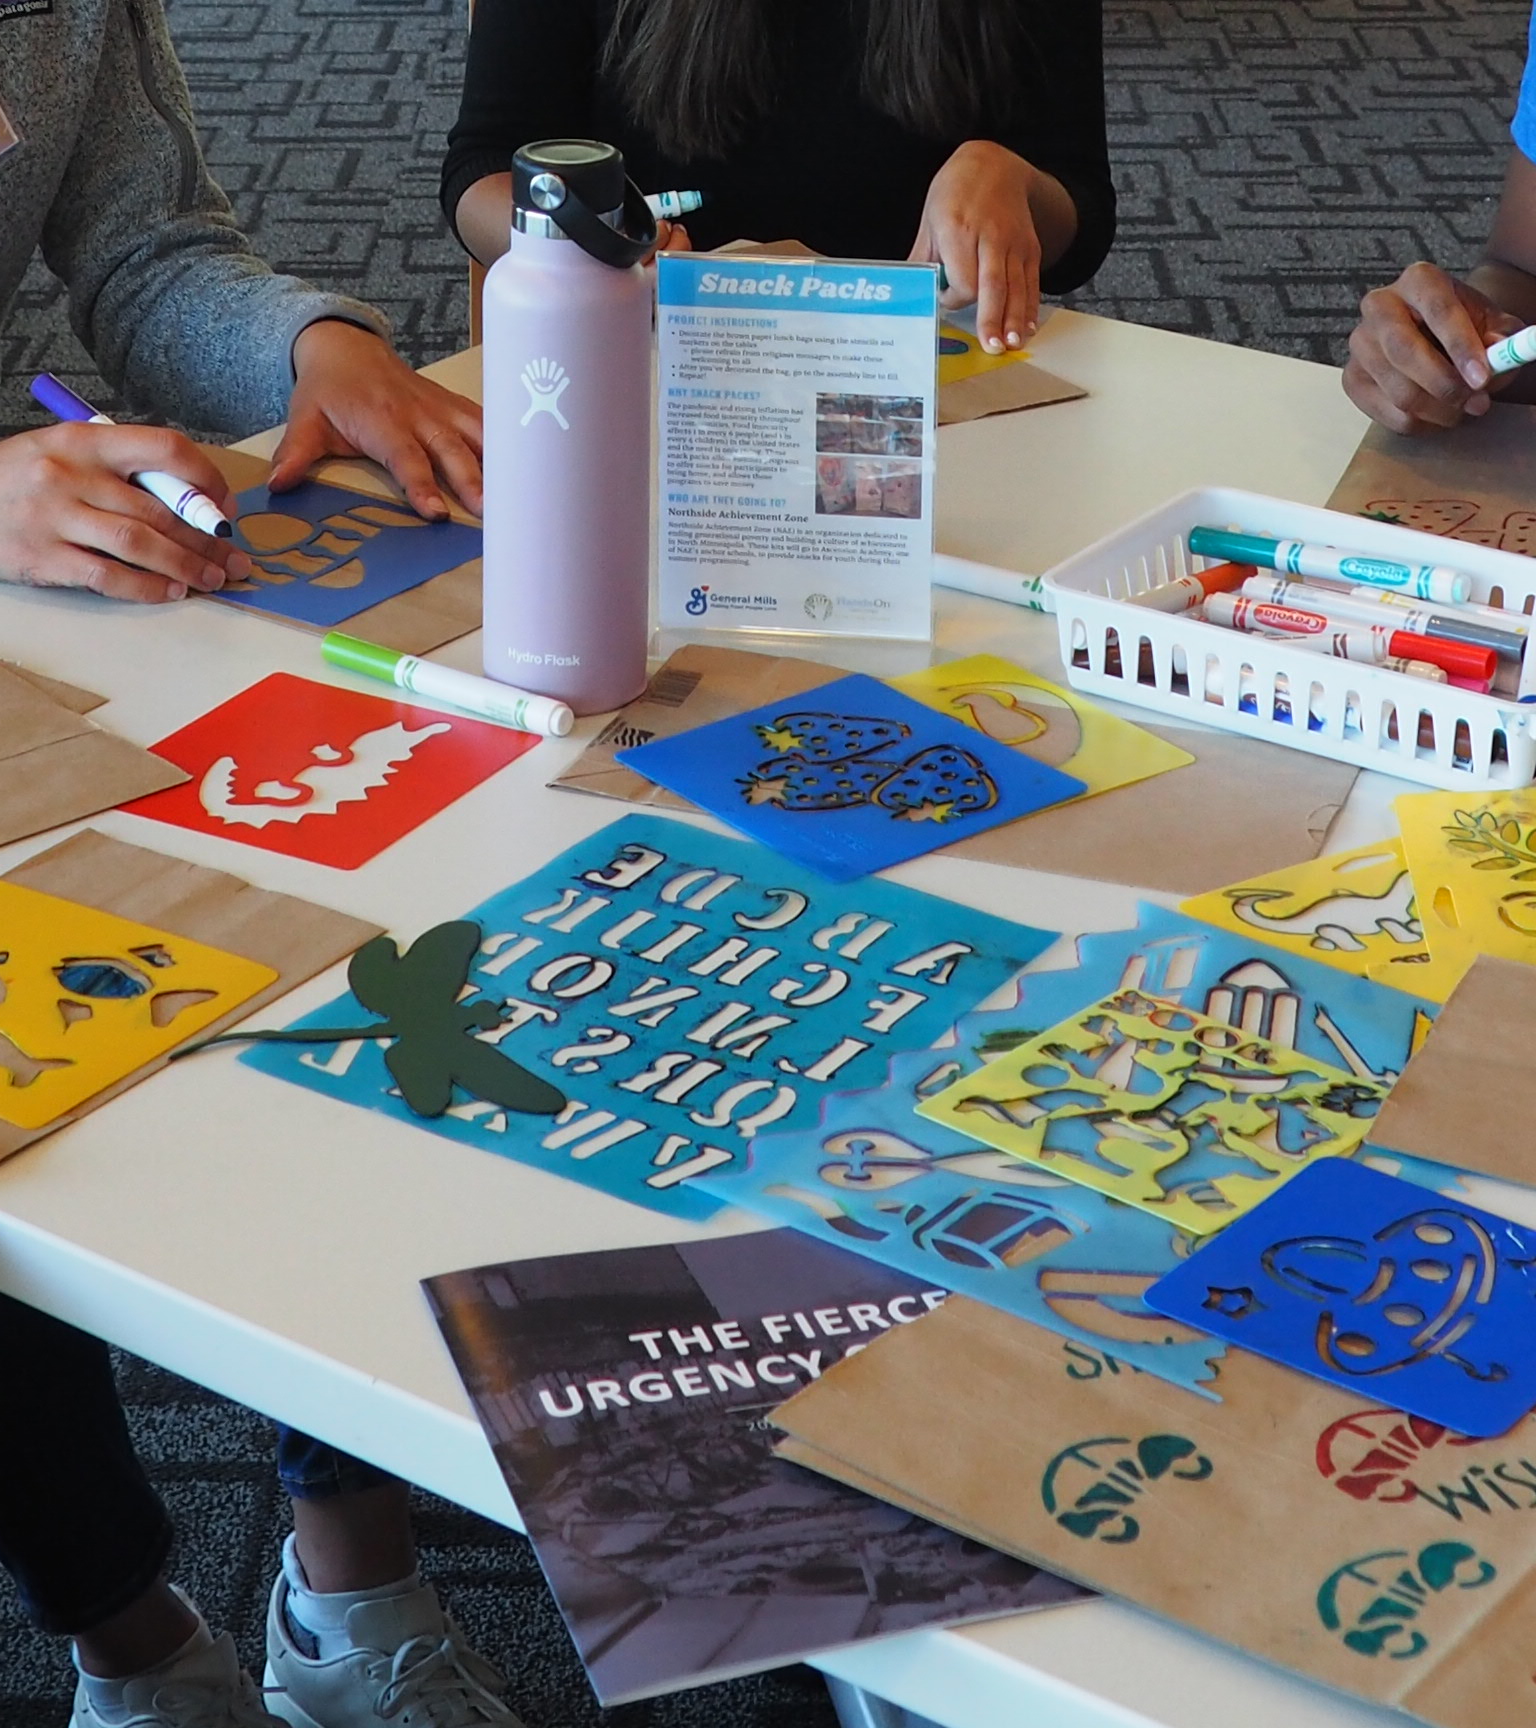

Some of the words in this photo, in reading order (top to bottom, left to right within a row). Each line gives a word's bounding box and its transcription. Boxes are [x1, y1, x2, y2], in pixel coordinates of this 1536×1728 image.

[698, 273, 797, 298] Snack
[799, 276, 892, 301] Packs
[668, 314, 706, 325] PROJECT
[710, 316, 777, 328] INSTRUCTIONS
[668, 387, 686, 396] WHY
[690, 388, 720, 398] SNACK
[724, 390, 760, 400] PACKS?
[668, 493, 688, 503] WHO
[692, 494, 708, 504] ARE
[713, 495, 734, 505] THEY
[736, 496, 766, 507] GOING
[770, 498, 786, 508] TO?
[668, 507, 716, 518] Northside
[718, 509, 781, 521] Achievement
[784, 512, 808, 522] Zone
[1345, 560, 1404, 582] Crayola
[710, 594, 751, 604] General
[754, 596, 777, 605] Mills
[1263, 606, 1322, 629] Crayola
[507, 647, 542, 666] Hydro
[545, 650, 581, 668] Flask
[628, 1321, 748, 1361] THE
[762, 1289, 949, 1346] FIERCE
[538, 1349, 825, 1419] URGENCY
